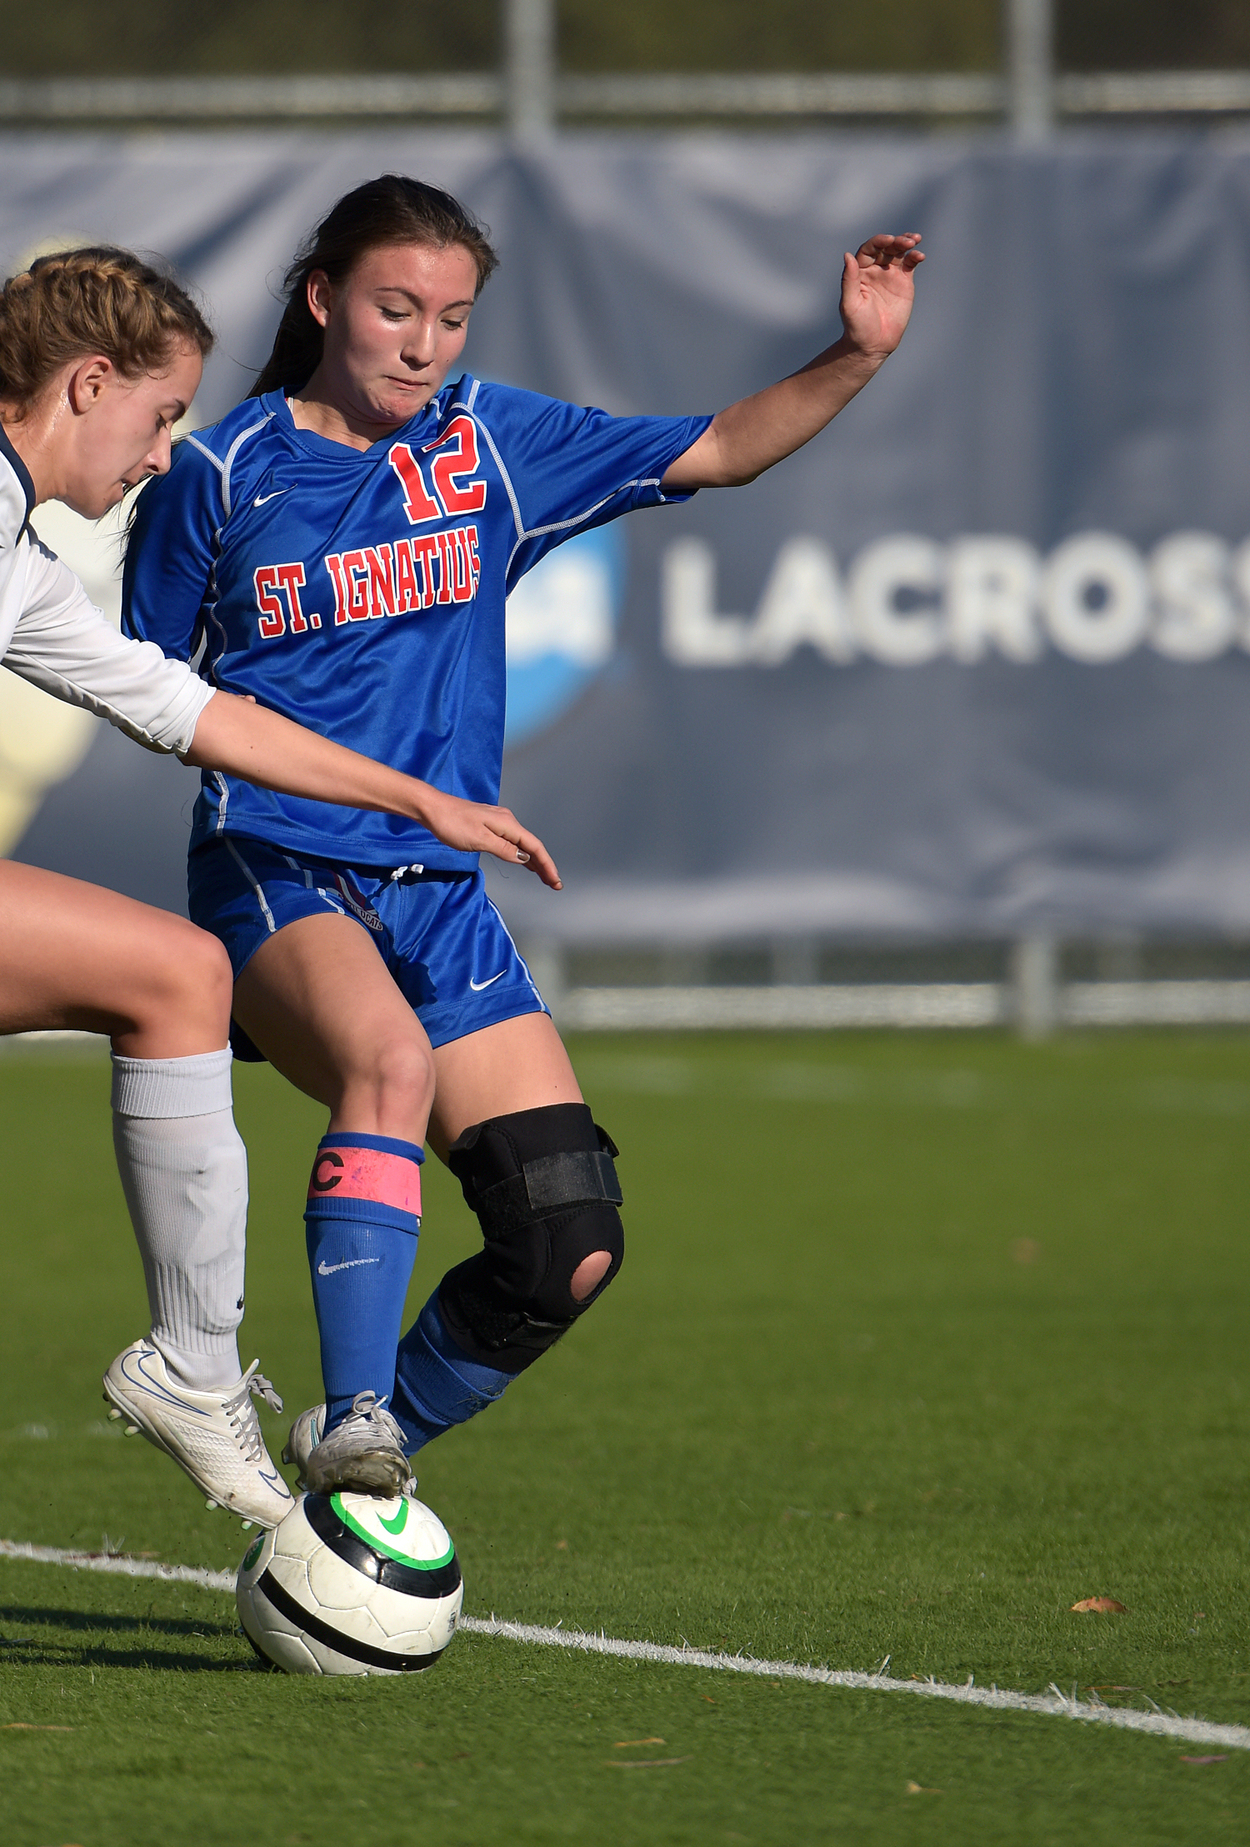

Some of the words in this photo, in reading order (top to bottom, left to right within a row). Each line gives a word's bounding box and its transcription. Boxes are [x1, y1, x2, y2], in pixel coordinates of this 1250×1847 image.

[387, 414, 488, 526] 12
[252, 561, 323, 640] ST.
[324, 524, 482, 627] IGNATIUS
[660, 530, 1250, 669] LACROS
[312, 1151, 345, 1192] C
